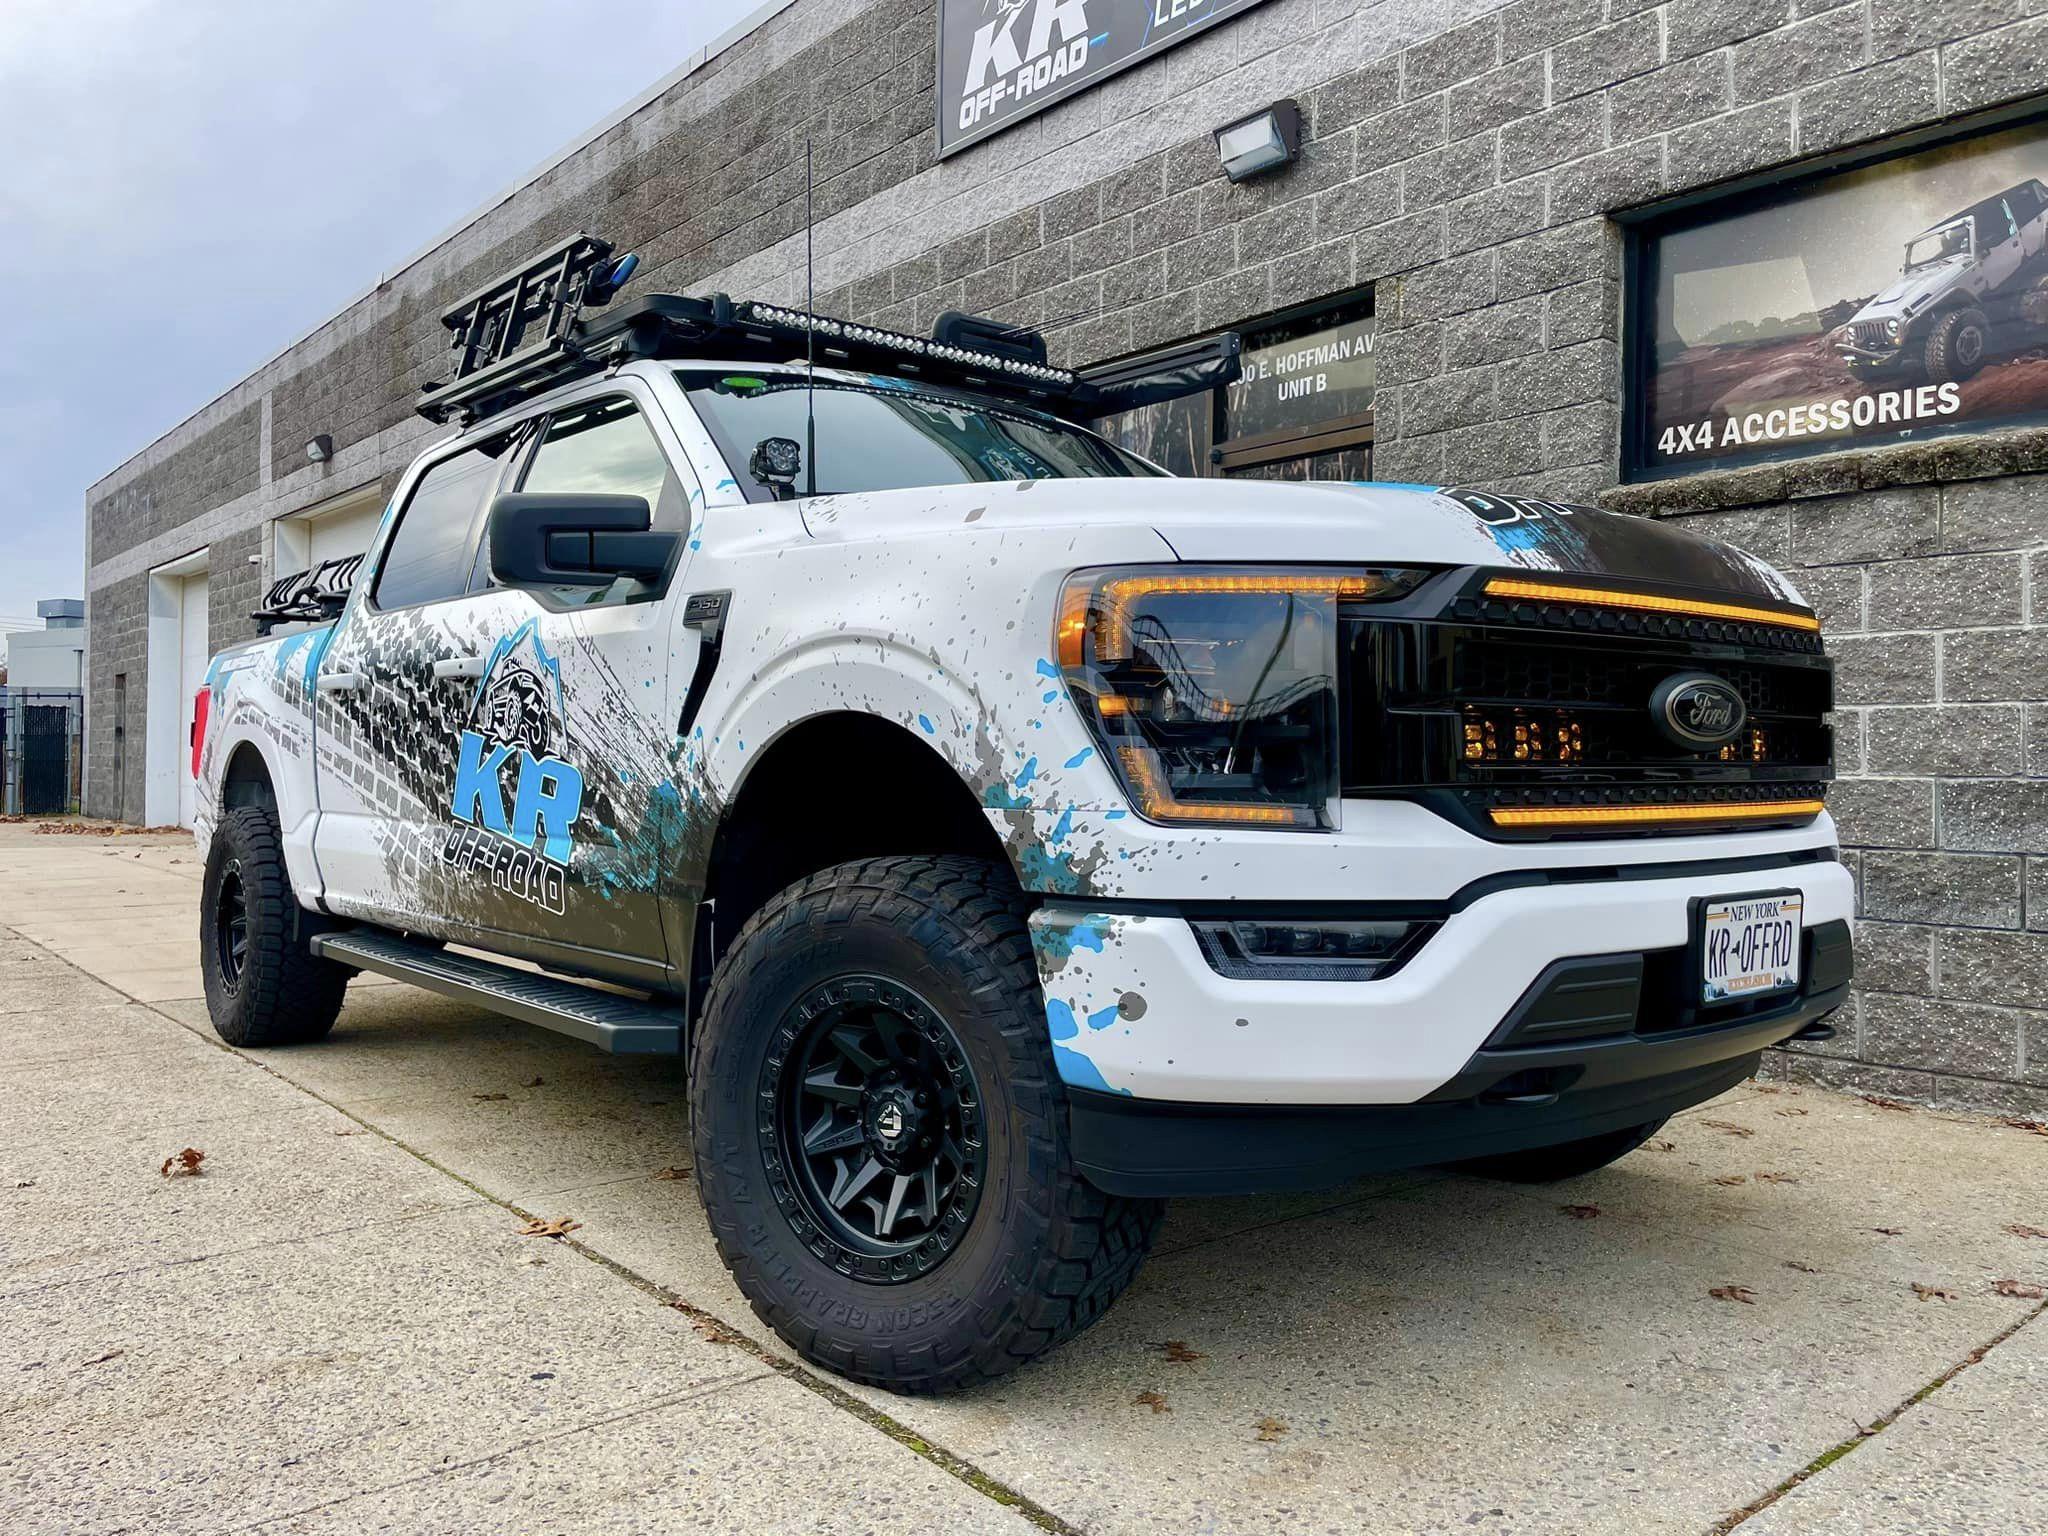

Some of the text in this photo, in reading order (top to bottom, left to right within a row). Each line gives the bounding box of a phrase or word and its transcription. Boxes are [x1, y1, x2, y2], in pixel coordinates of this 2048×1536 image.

[958, 35, 1089, 131] OFF-ROAD
[961, 0, 1090, 98] KR
[1259, 360, 1272, 380] E.
[1276, 339, 1350, 376] HOFFMAN
[1278, 373, 1327, 401] UNIT B
[1657, 381, 1961, 456] 4X4 ACCESSORIES
[1690, 690, 1733, 726] Ford
[450, 728, 584, 867] KR
[442, 819, 566, 916] OFF-ROAD
[1730, 901, 1781, 922] NEW YORK
